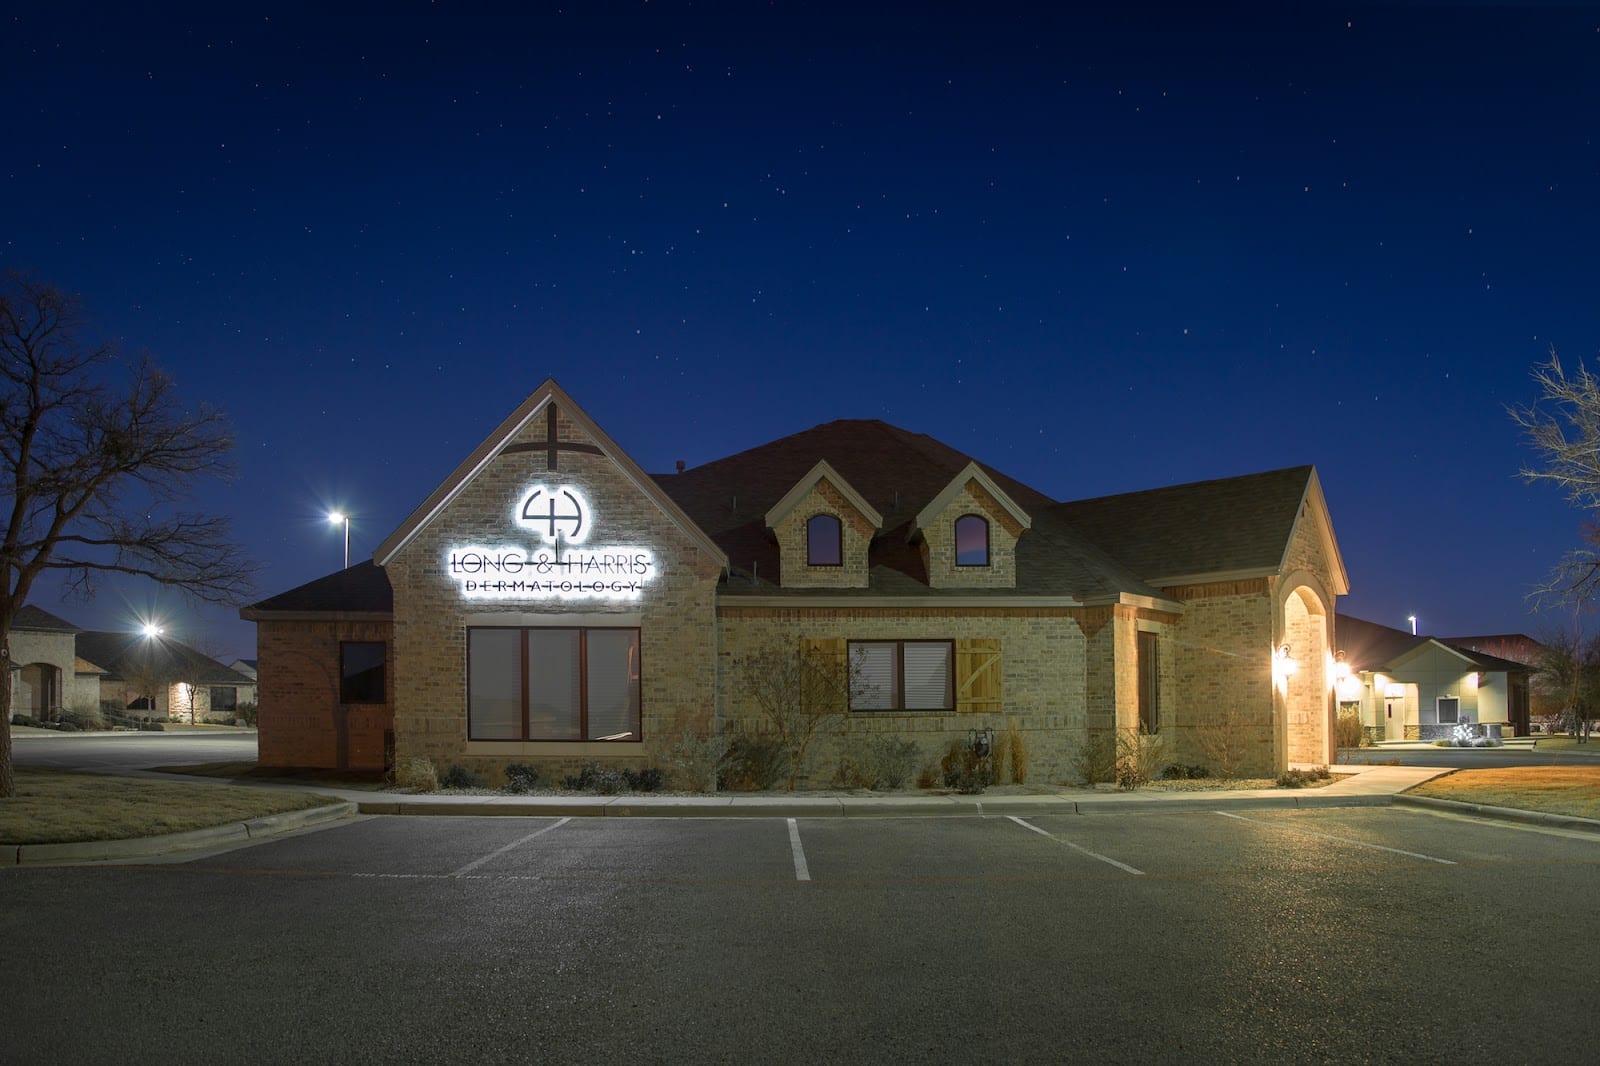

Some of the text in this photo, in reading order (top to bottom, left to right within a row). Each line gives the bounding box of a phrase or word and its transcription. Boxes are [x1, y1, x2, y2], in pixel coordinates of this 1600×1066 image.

[452, 553, 647, 575] LONG & HARRIS
[466, 580, 638, 592] DERMATOLOGY
